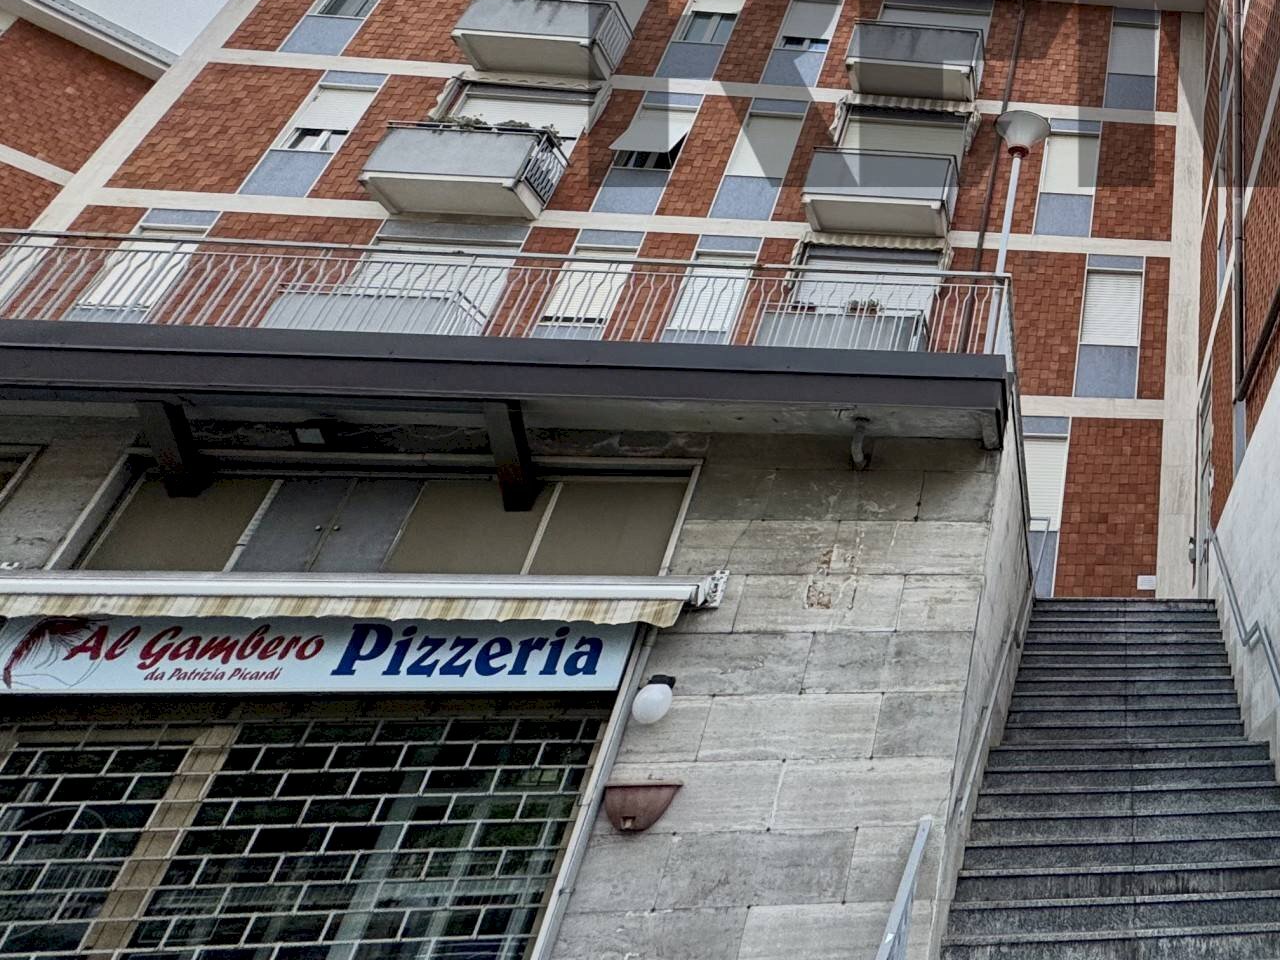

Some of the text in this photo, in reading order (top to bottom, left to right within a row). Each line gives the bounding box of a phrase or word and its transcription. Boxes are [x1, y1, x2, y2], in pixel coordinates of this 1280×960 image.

[64, 623, 326, 670] Al Gambero
[332, 623, 605, 678] Pizzeria
[144, 666, 283, 681] da Patrizia Picardi
